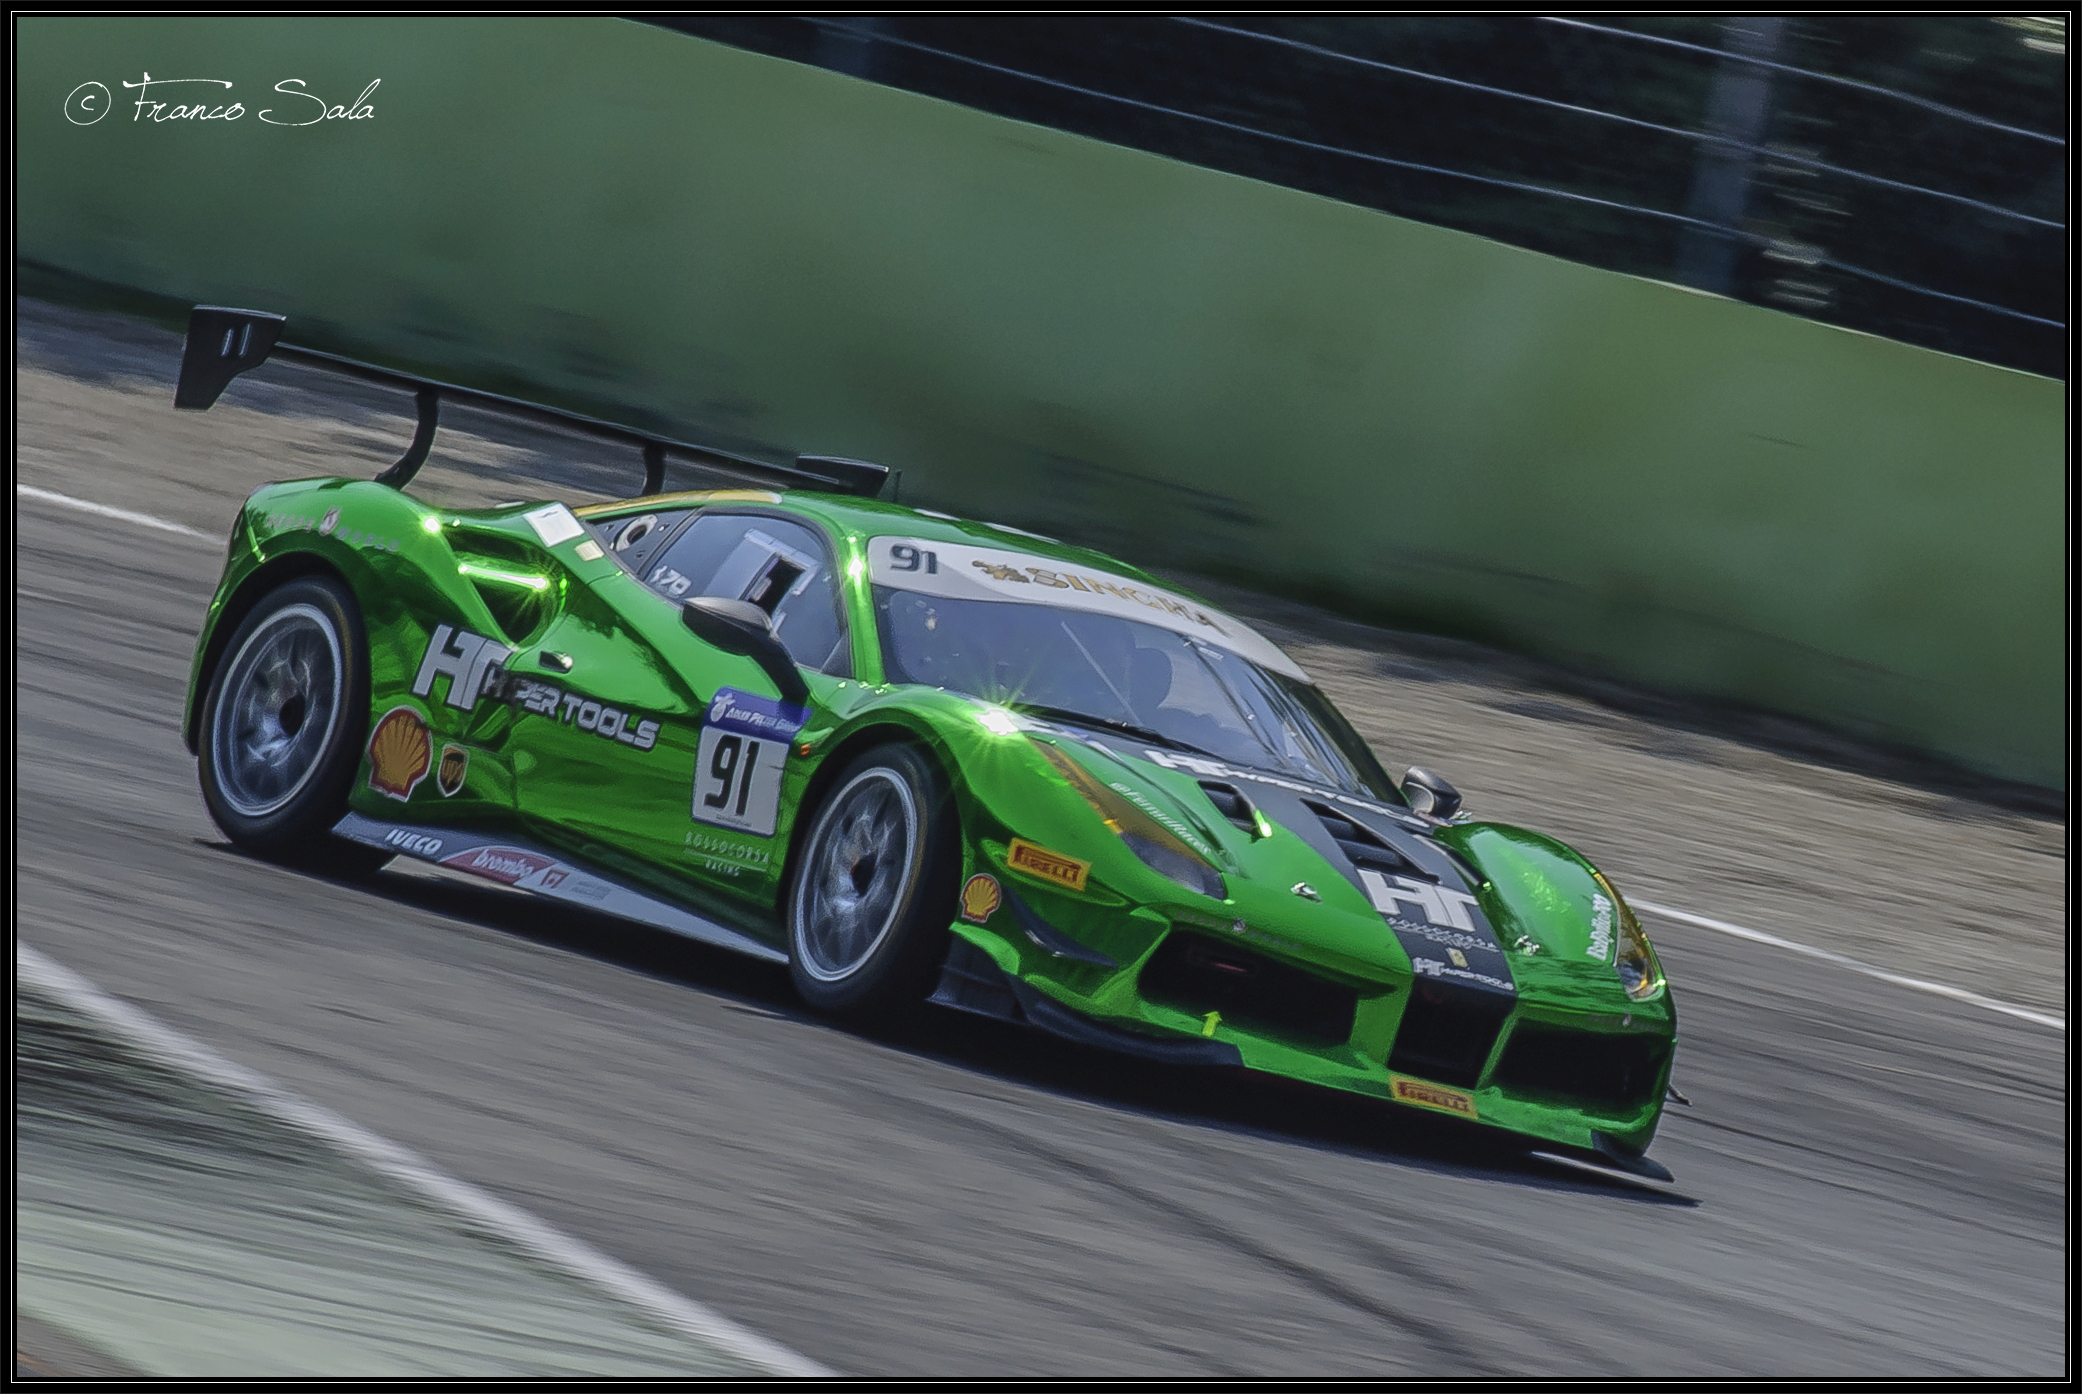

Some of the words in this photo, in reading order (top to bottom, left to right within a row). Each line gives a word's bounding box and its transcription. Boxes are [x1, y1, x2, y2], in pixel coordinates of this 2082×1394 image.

[889, 544, 939, 575] 91
[412, 624, 515, 711] HT
[561, 691, 661, 750] TOOLS
[703, 734, 761, 817] 91
[385, 829, 444, 856] IVECO
[473, 848, 536, 879] brembo
[1013, 844, 1082, 883] PIRELLI
[1356, 868, 1480, 933] HT
[1397, 1081, 1469, 1113] PIRELLI
